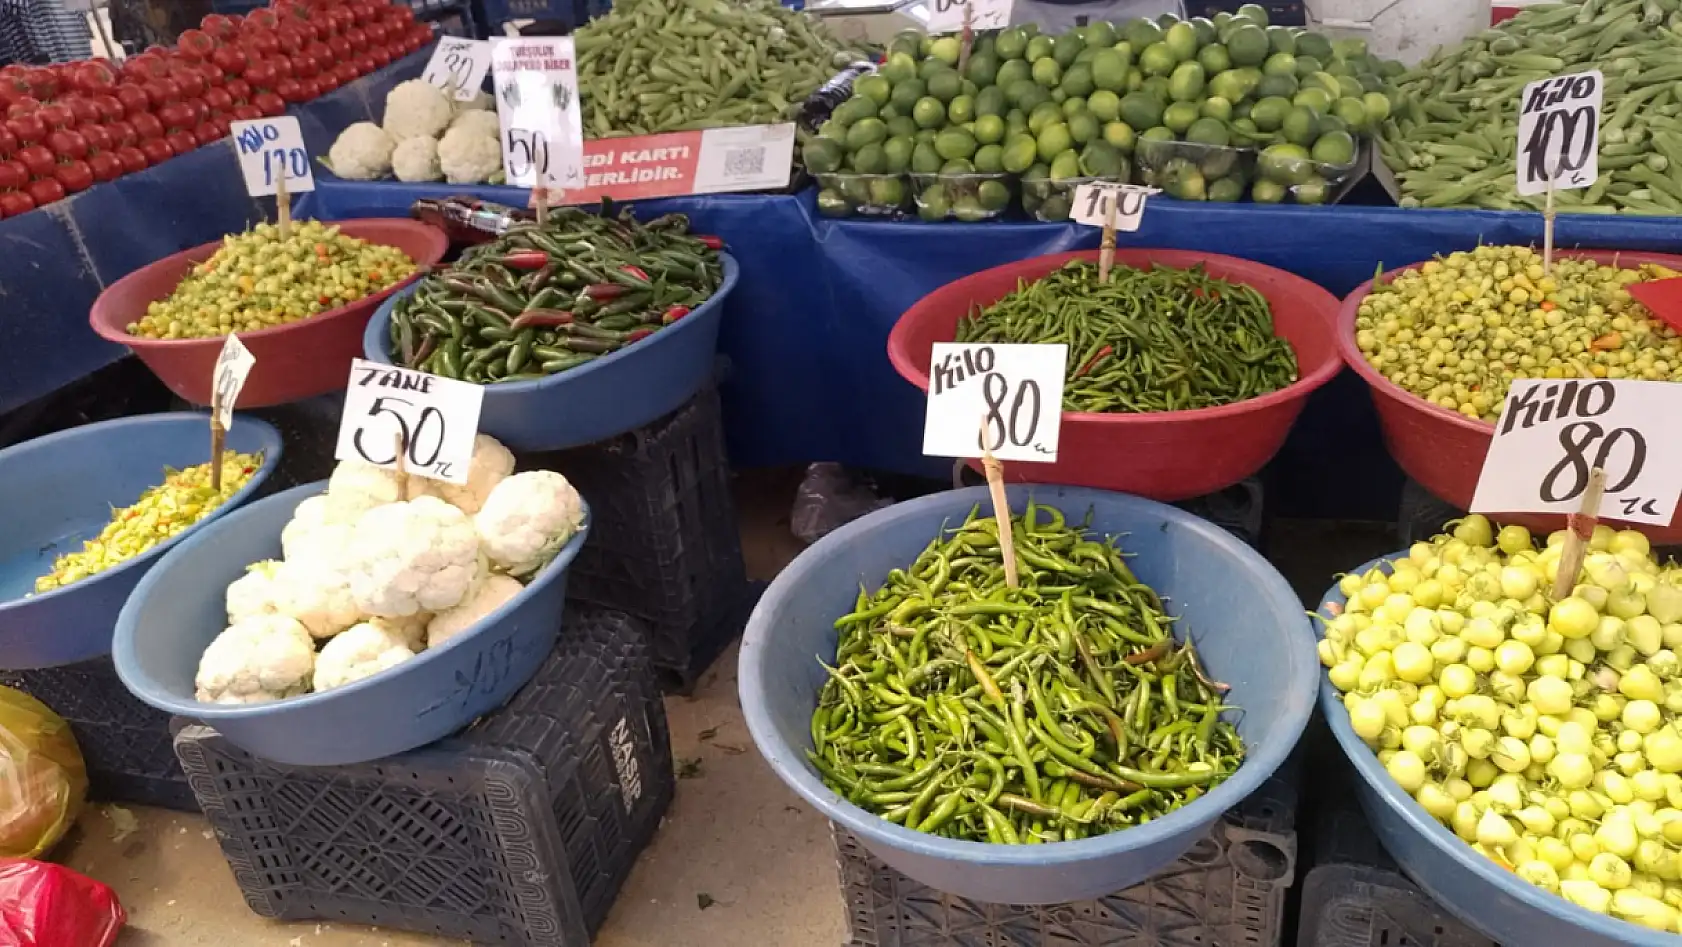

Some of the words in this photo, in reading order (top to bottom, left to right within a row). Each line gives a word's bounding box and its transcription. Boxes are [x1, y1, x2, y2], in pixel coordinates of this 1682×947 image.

[507, 128, 548, 177] 50
[585, 166, 684, 186] ERLİDİR.
[1523, 105, 1596, 182] 100
[355, 366, 436, 393] TANE
[978, 372, 1041, 451] 80
[353, 396, 445, 467] 50
[1540, 421, 1647, 503] 80
